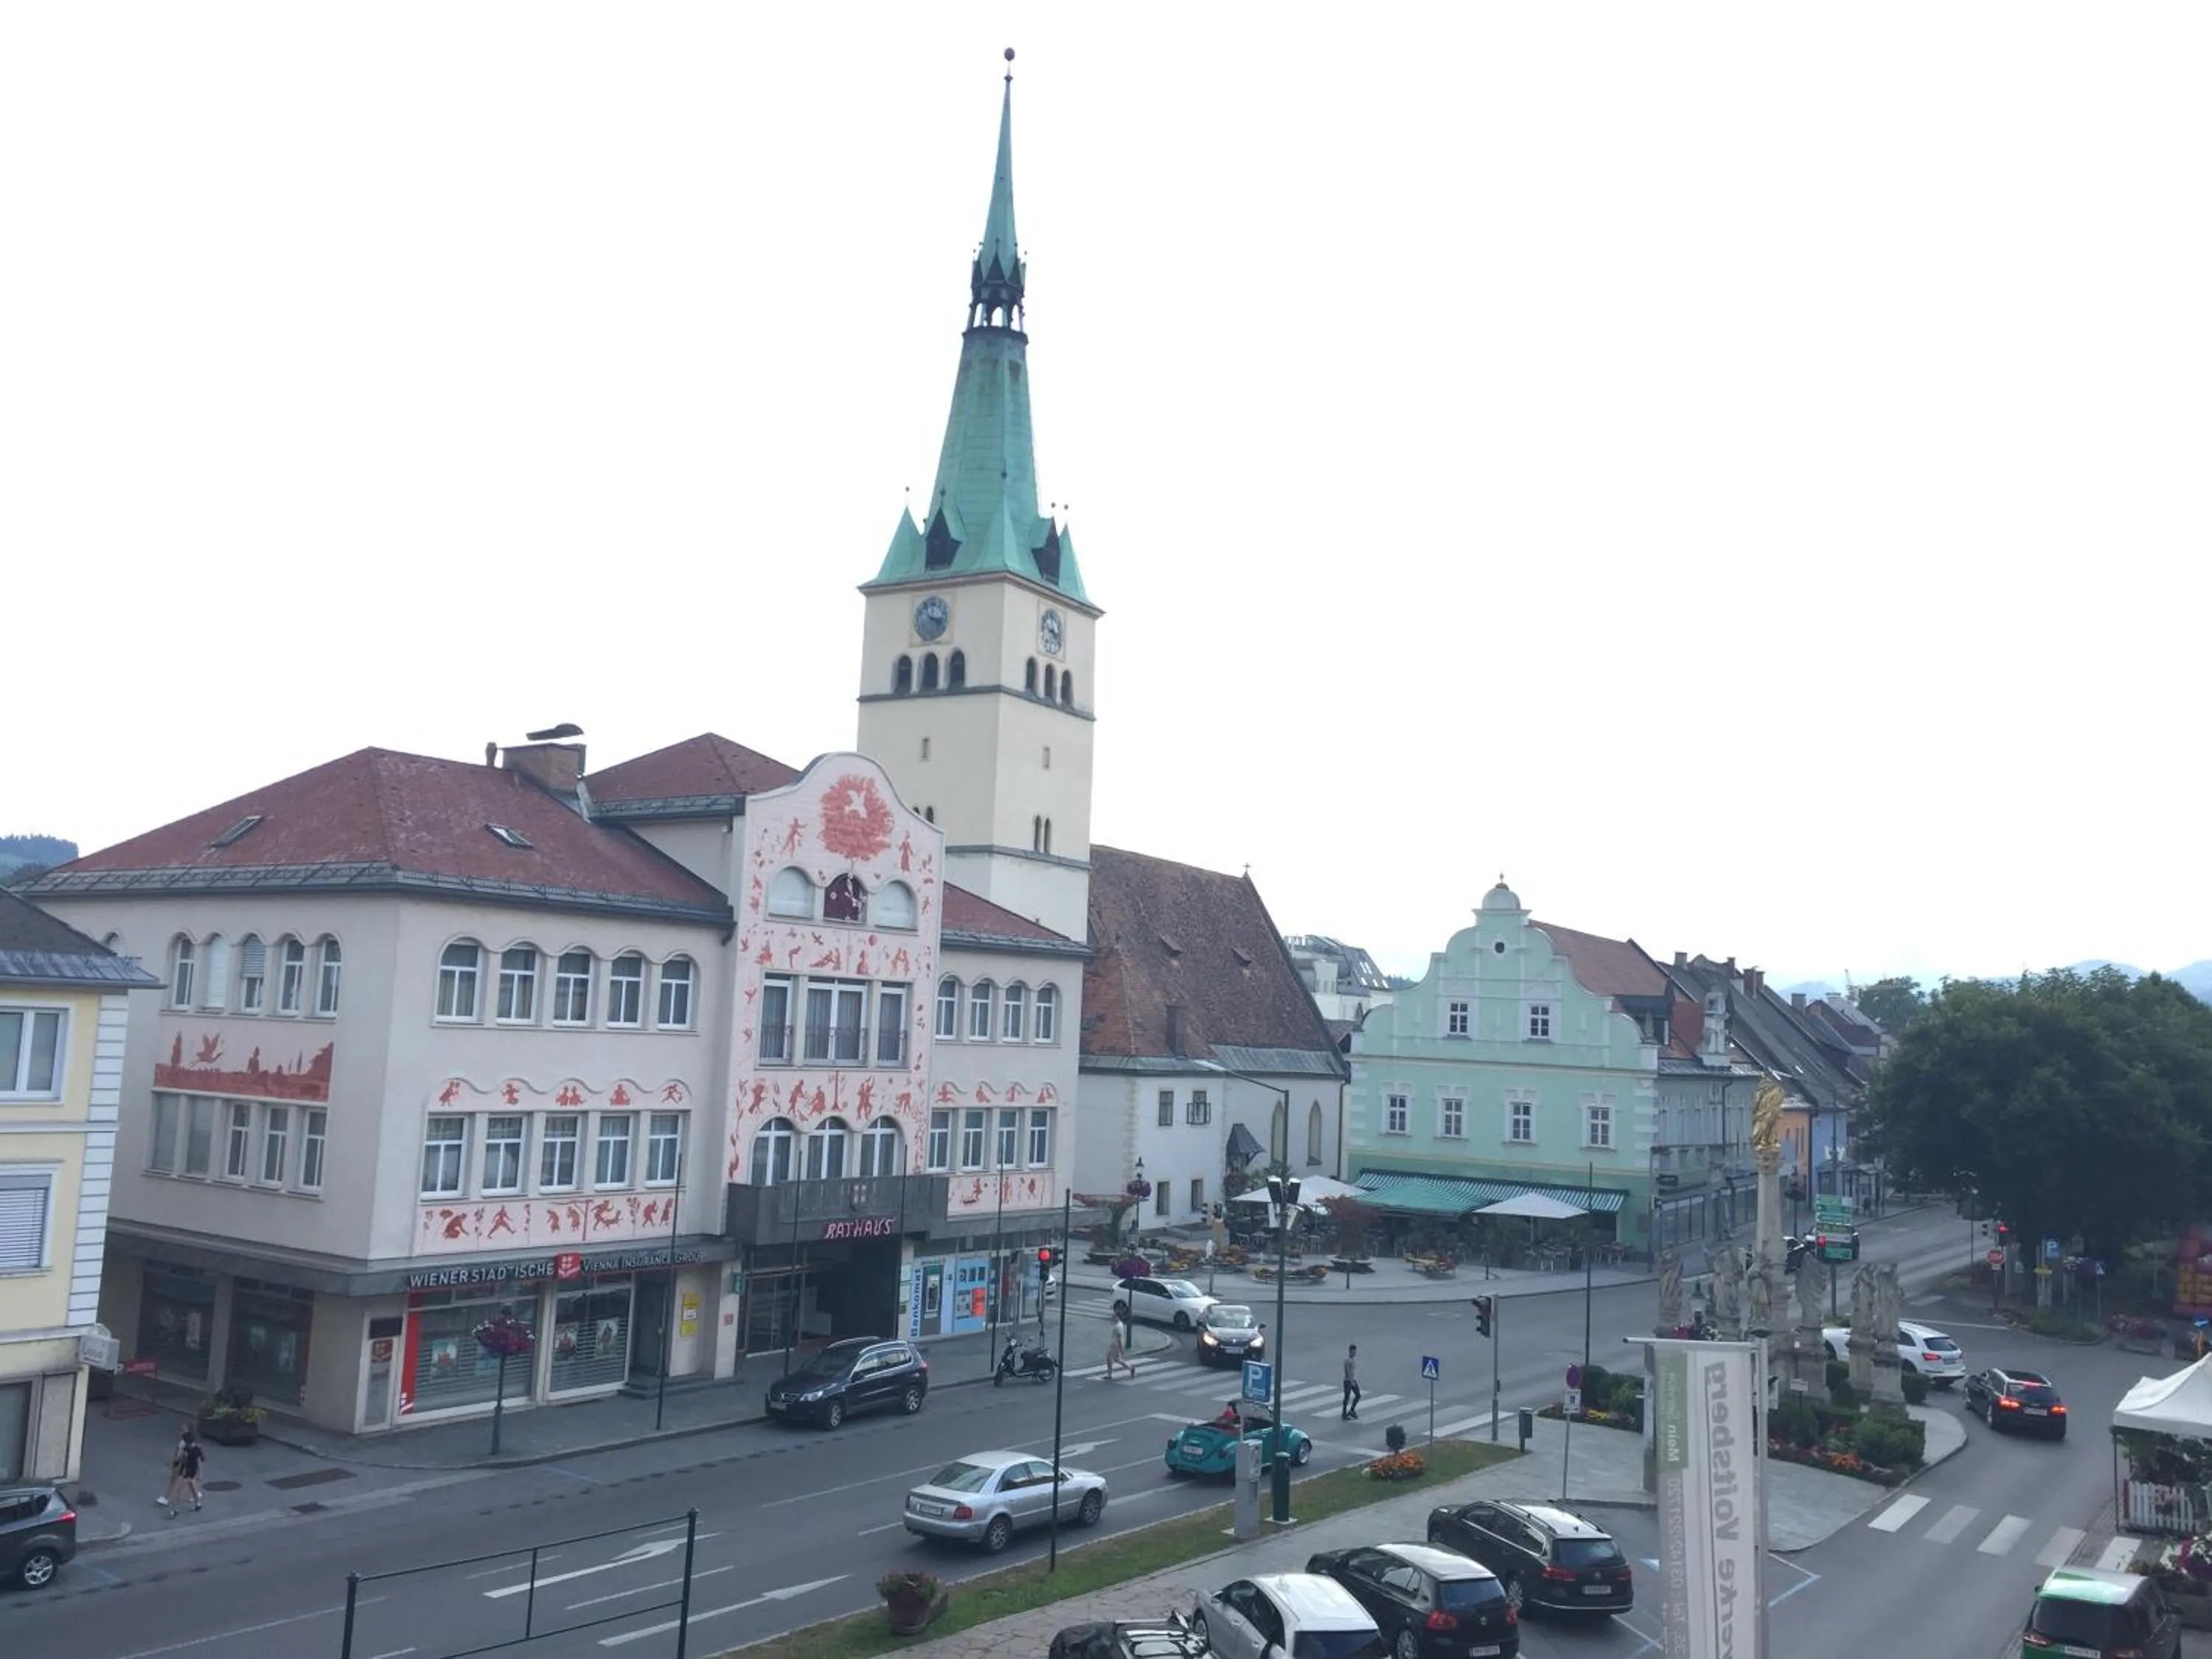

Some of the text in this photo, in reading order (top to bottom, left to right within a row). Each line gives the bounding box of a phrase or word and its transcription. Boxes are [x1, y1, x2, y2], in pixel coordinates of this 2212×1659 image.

[824, 1217, 897, 1239] RATHAUS
[410, 1269, 468, 1287] WIENER
[582, 1258, 619, 1273] VIENNA
[674, 1251, 706, 1264] GROUP
[910, 1267, 922, 1338] Bankomat
[1248, 1365, 1263, 1388] P
